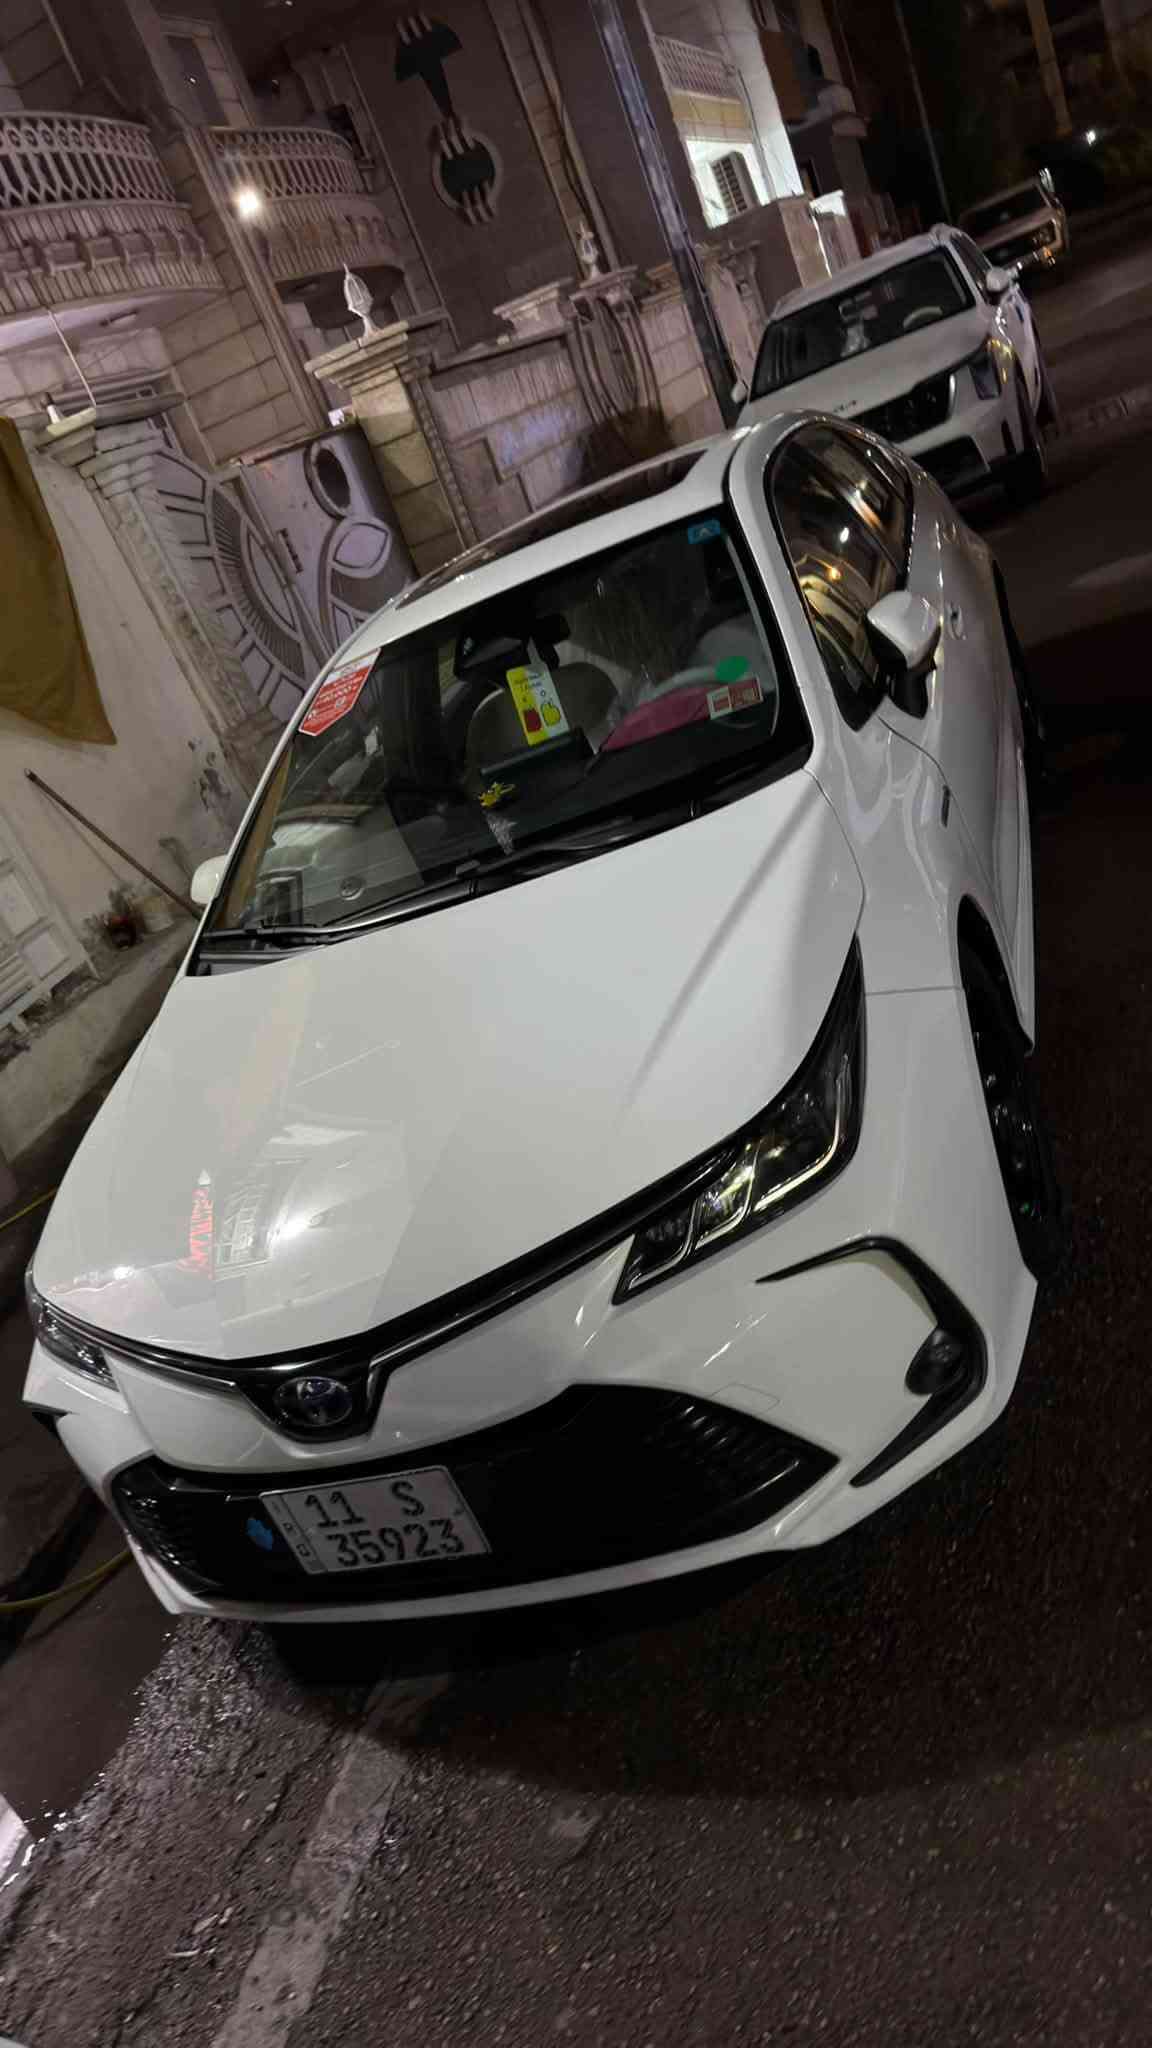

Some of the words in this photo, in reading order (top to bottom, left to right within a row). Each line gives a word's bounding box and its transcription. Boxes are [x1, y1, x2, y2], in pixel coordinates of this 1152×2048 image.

[305, 1491, 364, 1527] 11
[391, 1481, 424, 1516] S
[327, 1518, 464, 1567] 35923
